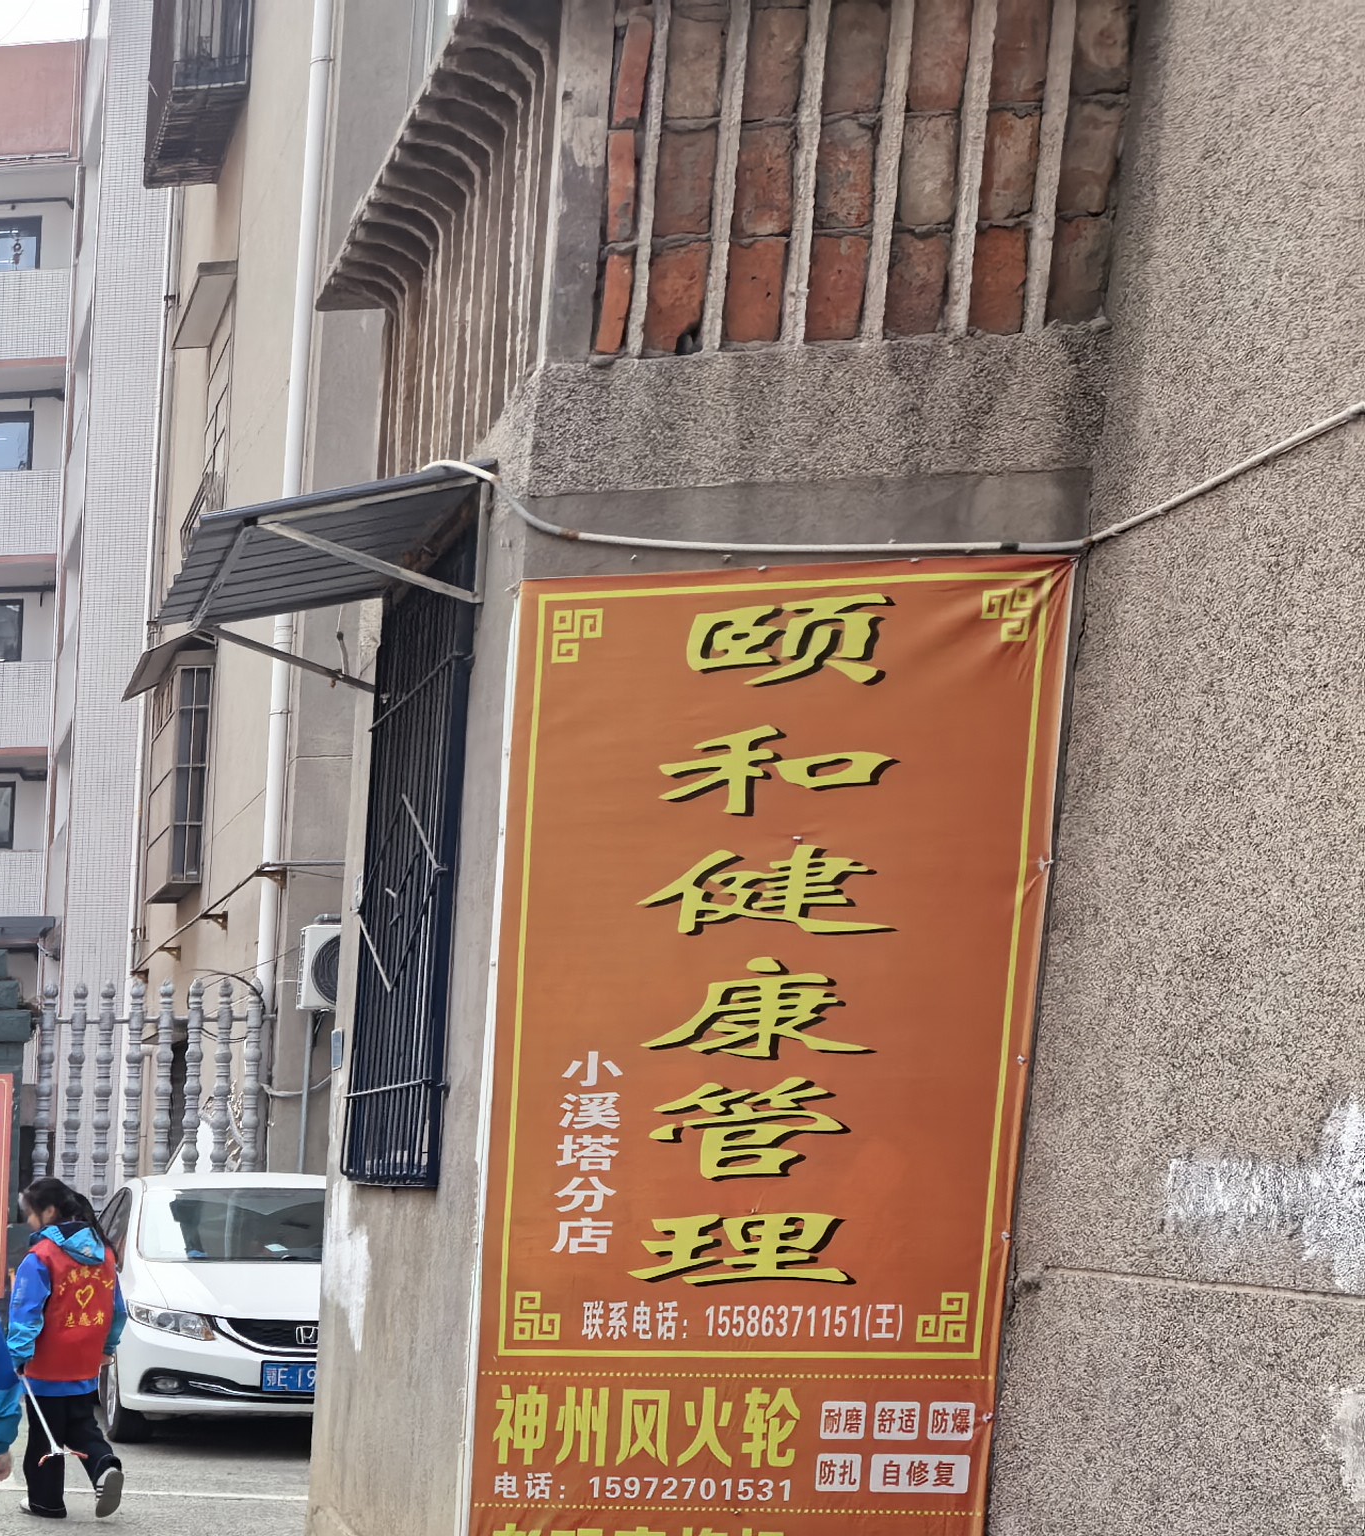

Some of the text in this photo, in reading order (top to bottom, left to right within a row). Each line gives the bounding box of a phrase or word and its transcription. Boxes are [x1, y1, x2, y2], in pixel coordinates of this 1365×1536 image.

[627, 593, 902, 1286] 颐和健康管理
[551, 1051, 623, 1254] 小溪塔分店
[493, 1385, 800, 1468] 神州风火轮
[823, 1407, 863, 1433] 耐磨
[877, 1407, 916, 1433] 舒适
[931, 1407, 970, 1434] 防爆
[818, 1460, 857, 1486] 防扎
[882, 1461, 955, 1487] 自修复
